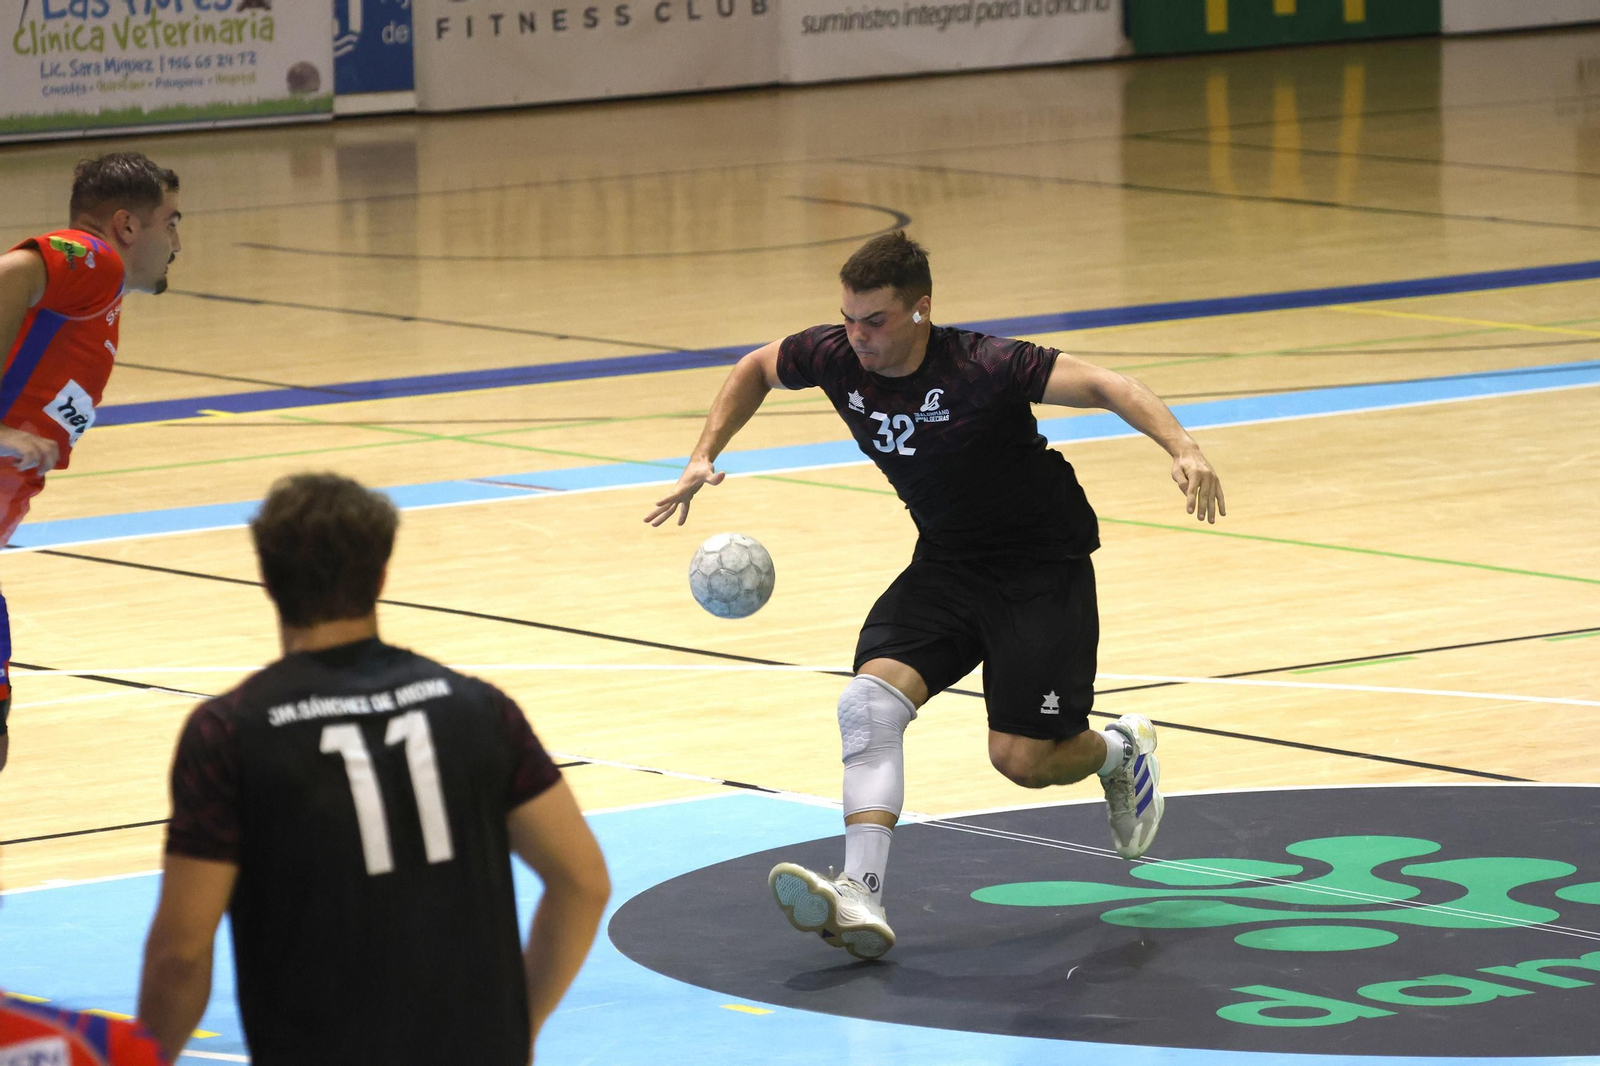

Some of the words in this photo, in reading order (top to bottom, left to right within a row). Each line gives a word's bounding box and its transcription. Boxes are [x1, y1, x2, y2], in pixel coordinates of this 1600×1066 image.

[112, 7, 275, 50] Veterinaria
[381, 20, 410, 45] de
[436, 5, 632, 40] FITNESS
[655, 0, 768, 23] CLUB
[801, 6, 899, 35] suministro
[974, 0, 1021, 28] para
[869, 411, 917, 456] 32
[319, 709, 455, 876] 11
